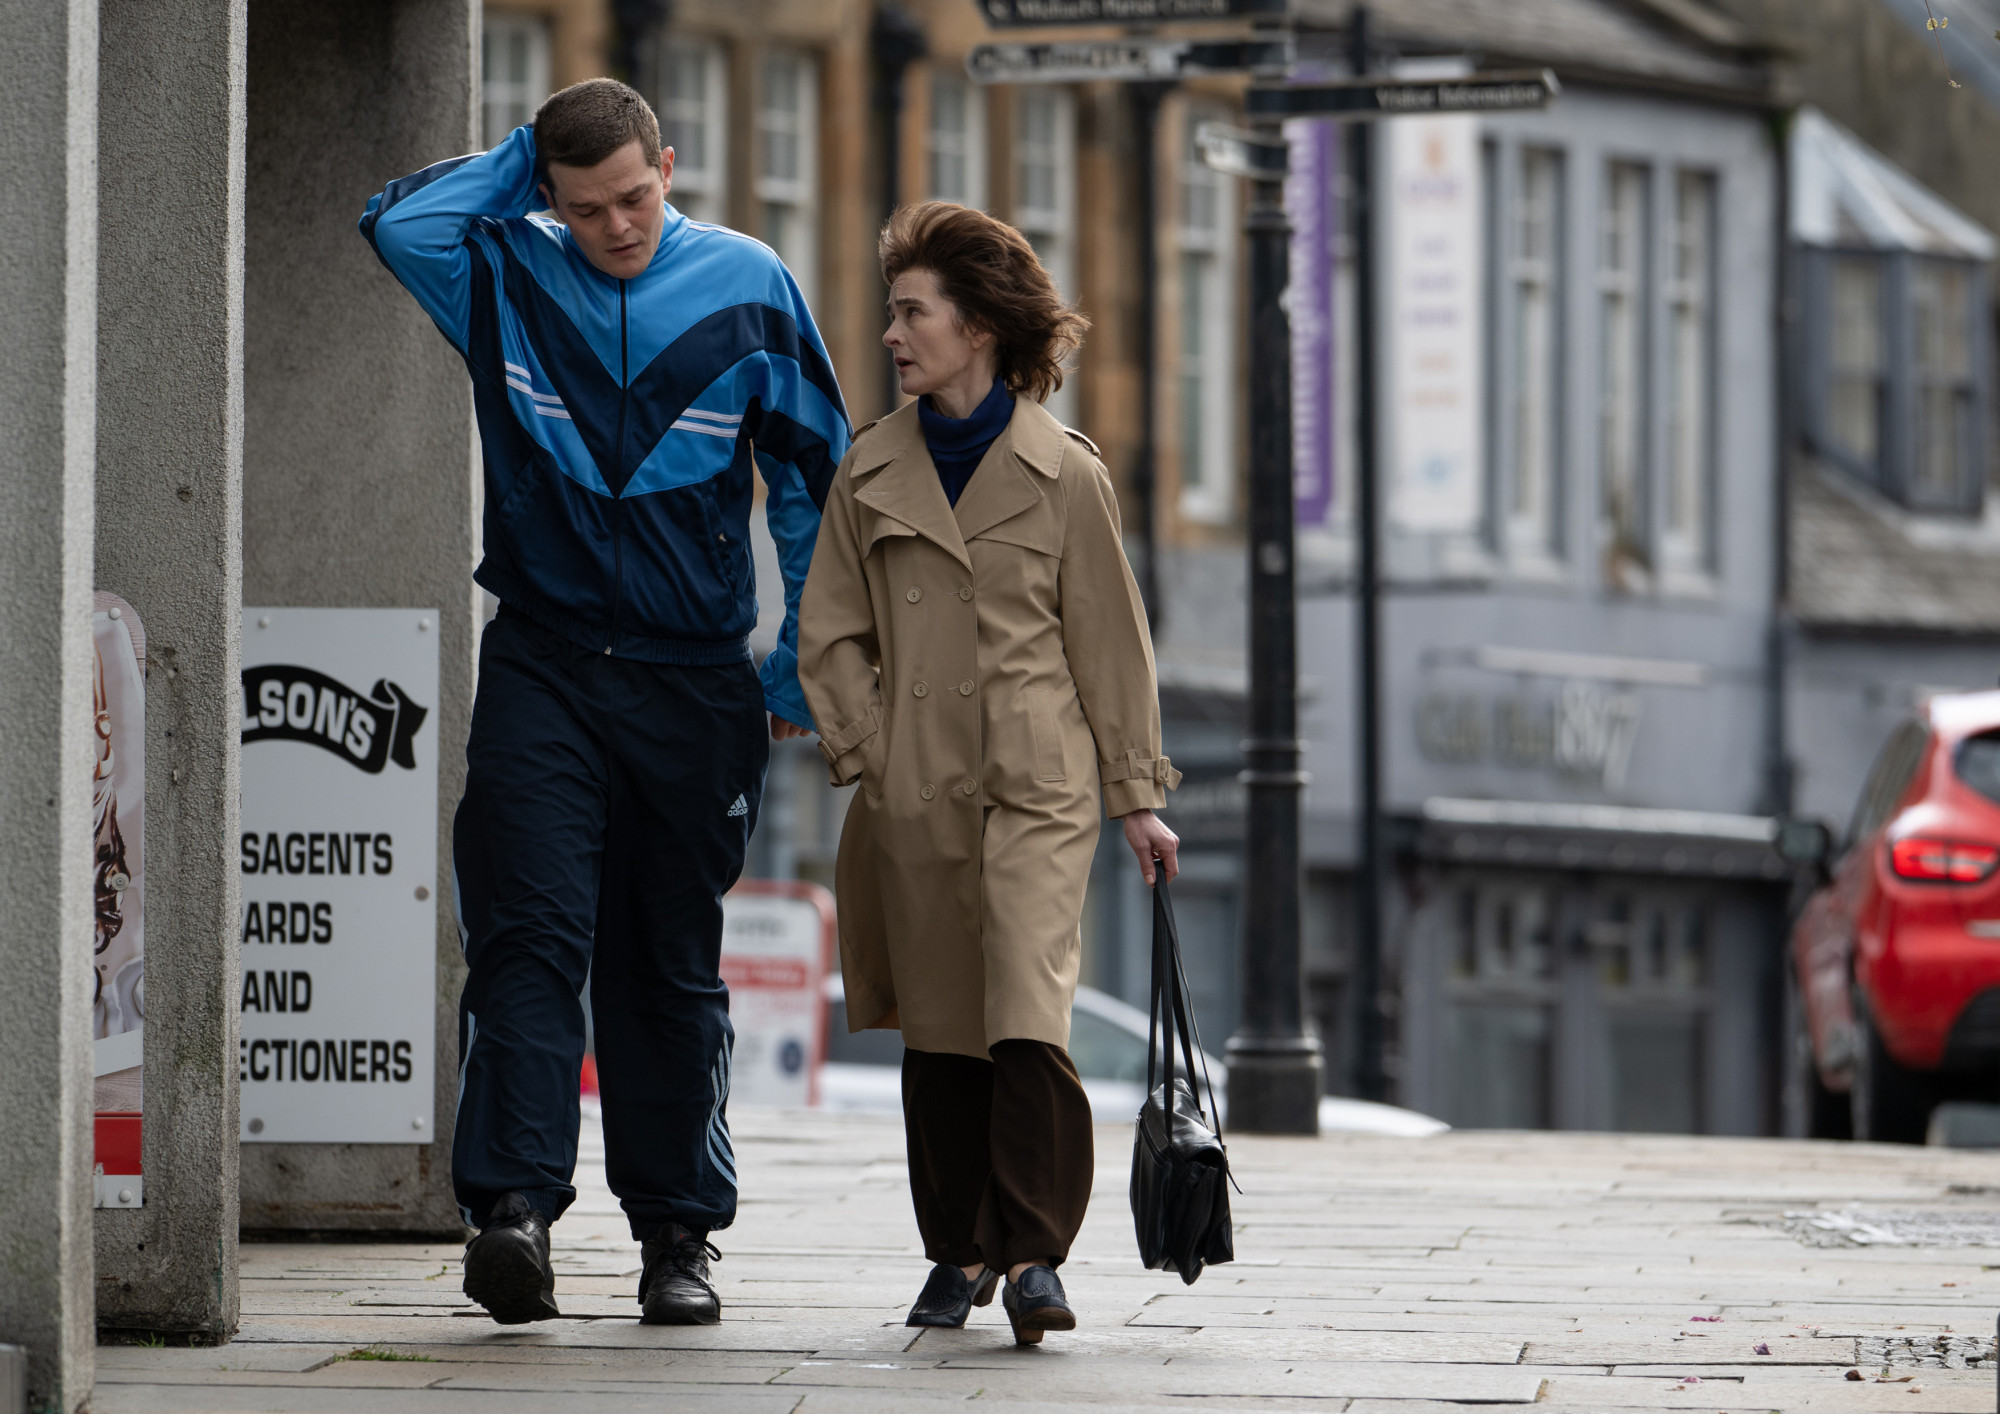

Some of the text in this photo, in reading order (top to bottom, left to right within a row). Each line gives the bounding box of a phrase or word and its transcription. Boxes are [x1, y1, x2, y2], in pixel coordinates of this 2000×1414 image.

[240, 832, 393, 876] SAGENTS
[242, 901, 333, 944] ARDS
[240, 970, 312, 1013] AND
